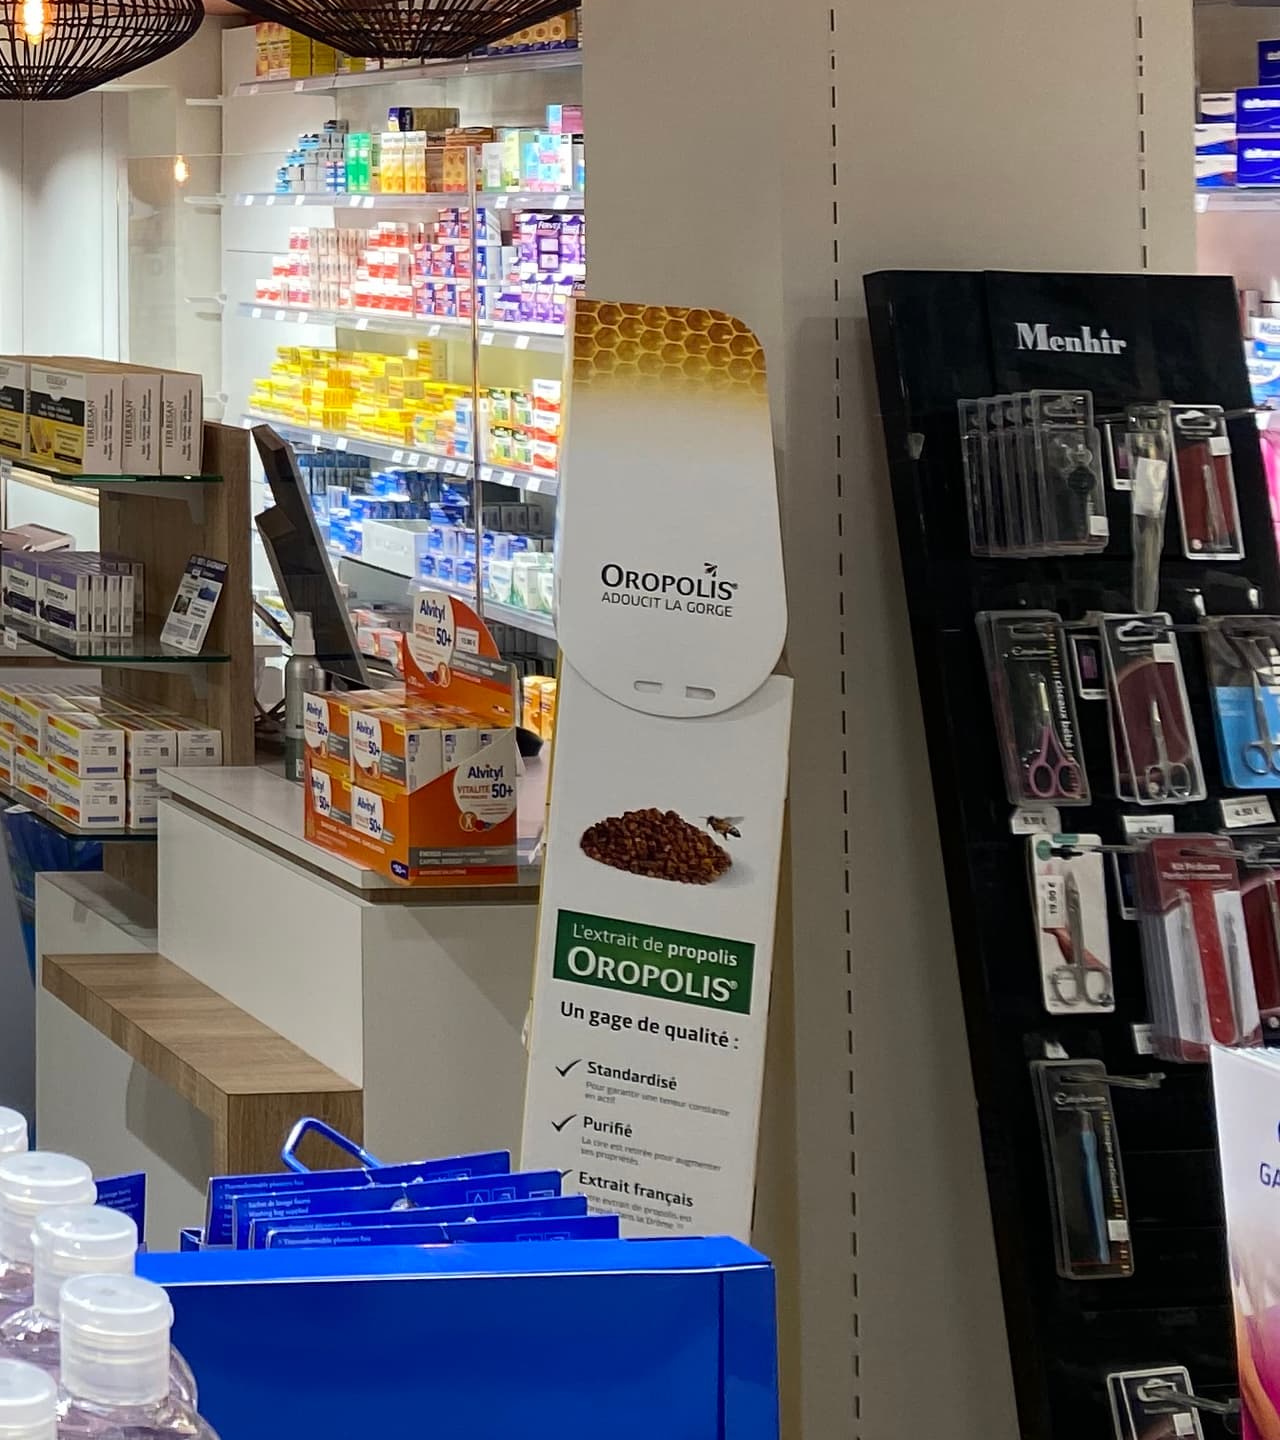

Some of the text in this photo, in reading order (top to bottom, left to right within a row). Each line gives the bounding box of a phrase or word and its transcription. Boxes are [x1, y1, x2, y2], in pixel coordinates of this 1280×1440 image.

[1015, 321, 1127, 356] Menhir
[88, 400, 96, 448] HERBESAN
[125, 400, 133, 448] HERBESAN
[166, 400, 174, 448] HERBESAN
[419, 599, 446, 623] Alvityl
[601, 591, 734, 618] ADOUCIT LA GORGE
[436, 628, 452, 648] 50+
[306, 702, 323, 718] Alvityl
[1054, 679, 1075, 748] ciseaux bébé
[317, 721, 329, 737] 50+
[356, 719, 375, 739] Alvityl
[368, 741, 381, 756] 50+
[467, 763, 505, 781] Alvityl
[491, 783, 514, 799] 50+
[357, 797, 376, 816] Alvityl
[368, 817, 382, 834] 50+
[572, 922, 738, 968] L'extrait de propolis
[567, 945, 731, 1003] OROPOLIS
[560, 1000, 585, 1020] Un
[589, 1008, 633, 1032] gage
[637, 1015, 660, 1035] de
[665, 1023, 729, 1050] qualité
[587, 1061, 678, 1091] Standardisé
[583, 1115, 633, 1138] Purifié
[578, 1171, 694, 1208] Extrait français
